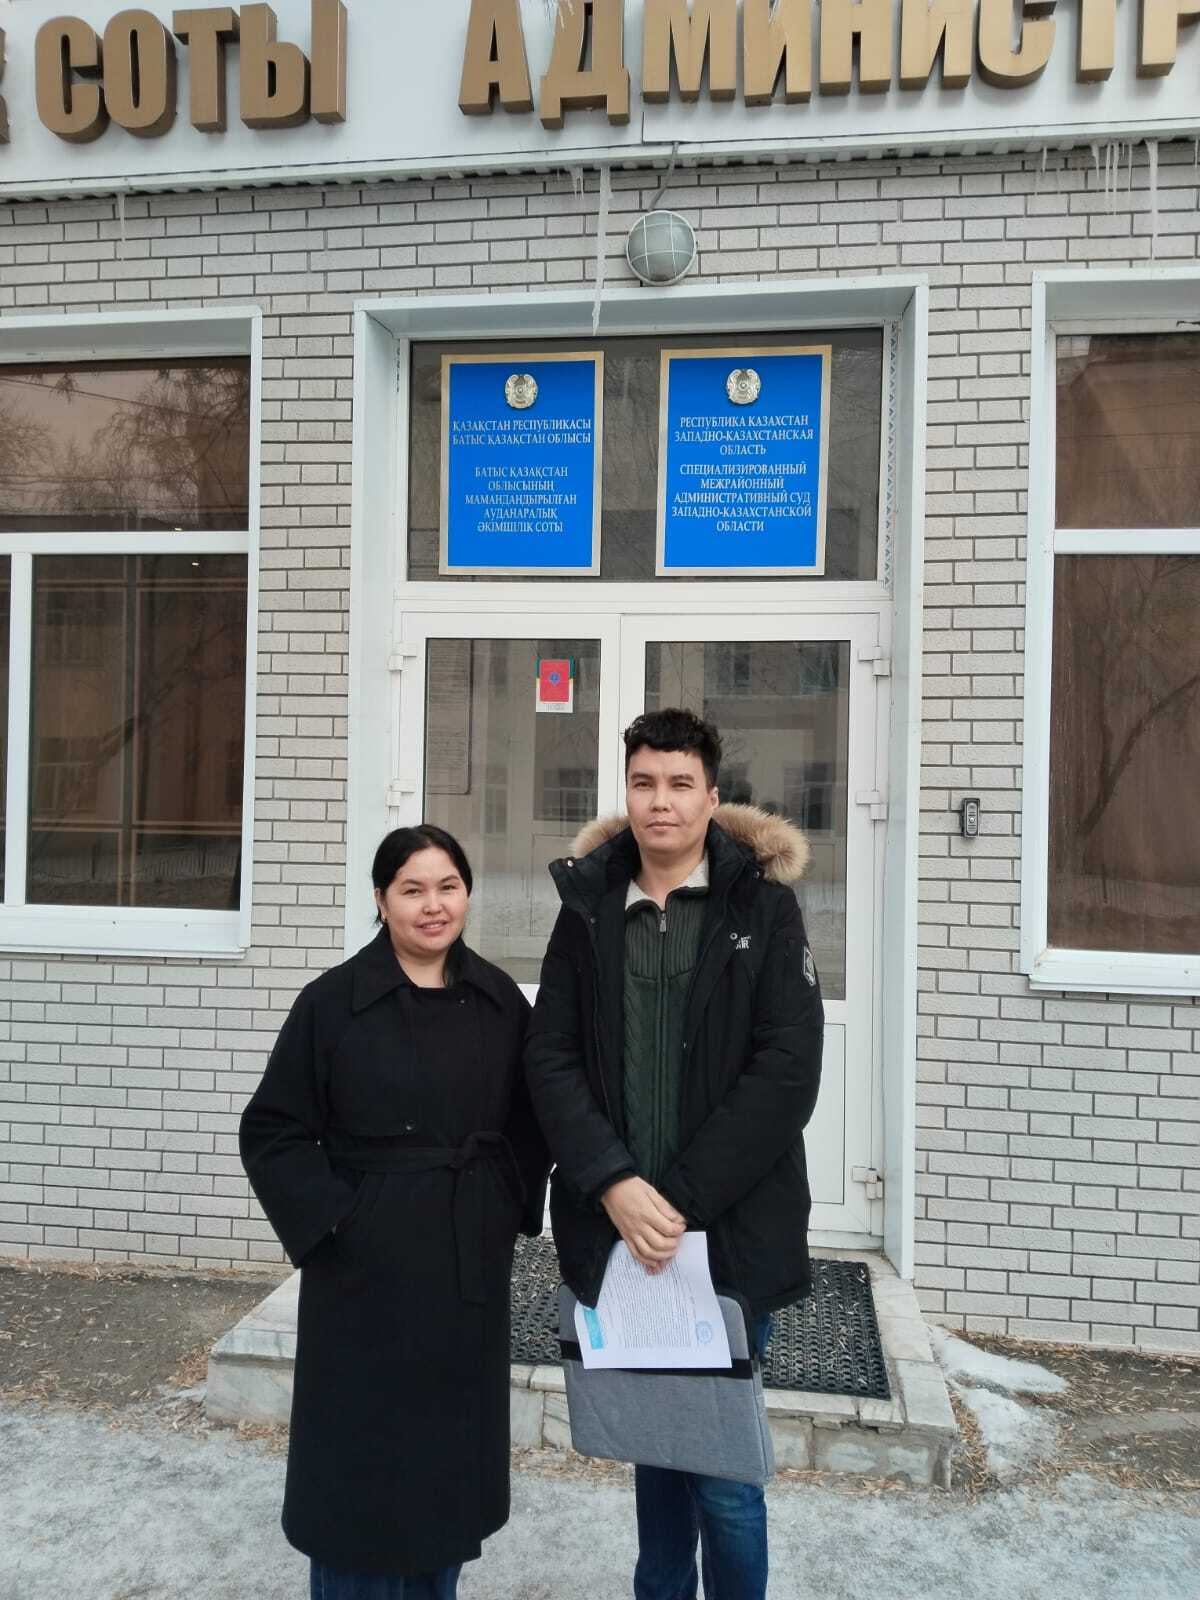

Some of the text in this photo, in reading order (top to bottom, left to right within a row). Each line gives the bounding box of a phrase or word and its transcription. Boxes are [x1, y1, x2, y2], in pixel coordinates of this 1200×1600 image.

[35, 3, 348, 144] СОТЫ
[513, 418, 591, 432] РЕСПУБЛИКАСЫ
[680, 415, 809, 428] РЕСПУБЛИКА КАЗАХСТАН
[453, 432, 591, 446] БАТЫС ҚАЗАҚСТАН ОБЛЫСЫ
[674, 429, 814, 442] ЗАПАДНО-КАЗАХСТАНСКАЯ
[719, 444, 767, 456] ОБЛАСТЬ
[475, 466, 568, 479] БАТЫС ҚАЗАҚСТАН
[680, 461, 807, 476] СПЕЦИАЛИЗИРОВАННЫЙ
[488, 480, 555, 492] ОБЛЫСЫНЫҢ
[700, 476, 785, 489] МЕЖРАЙОННЫЙ
[674, 490, 811, 505] АДМИНИСТРАТИВНЫЙ СУД
[671, 504, 812, 519] ЗАПАДНО-КАЗАХСТАНСКОЙ
[535, 521, 564, 533] СОТЫ
[716, 521, 765, 532] ОБЛАСТИ
